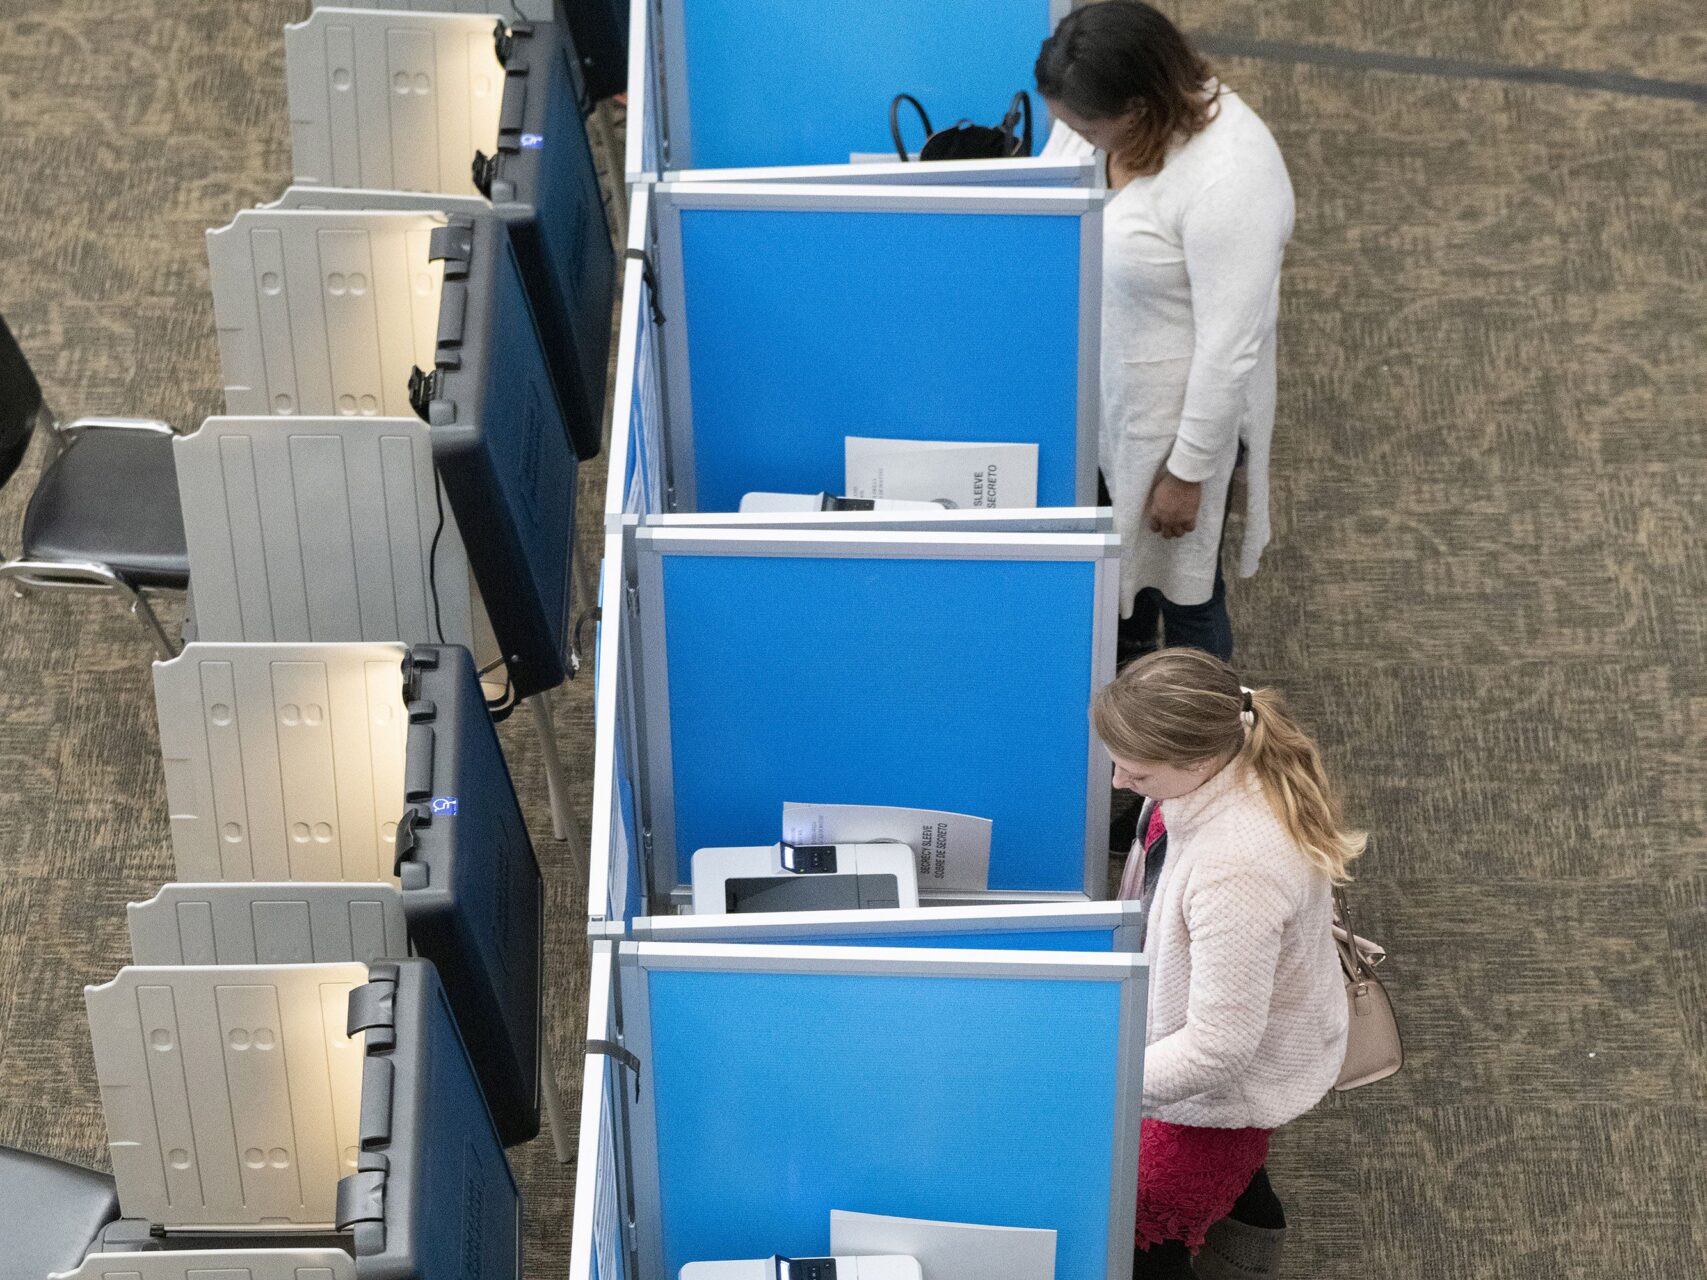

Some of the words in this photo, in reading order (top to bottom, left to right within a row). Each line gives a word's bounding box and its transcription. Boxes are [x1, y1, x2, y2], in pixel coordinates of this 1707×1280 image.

[973, 471, 984, 507] SLEEVE
[986, 464, 998, 508] SECRETO
[922, 825, 932, 846] SLEEVE
[936, 822, 947, 849] SECRETO
[920, 847, 931, 874] SECRECY
[935, 850, 945, 858] DE
[934, 859, 945, 879] SOBRE
